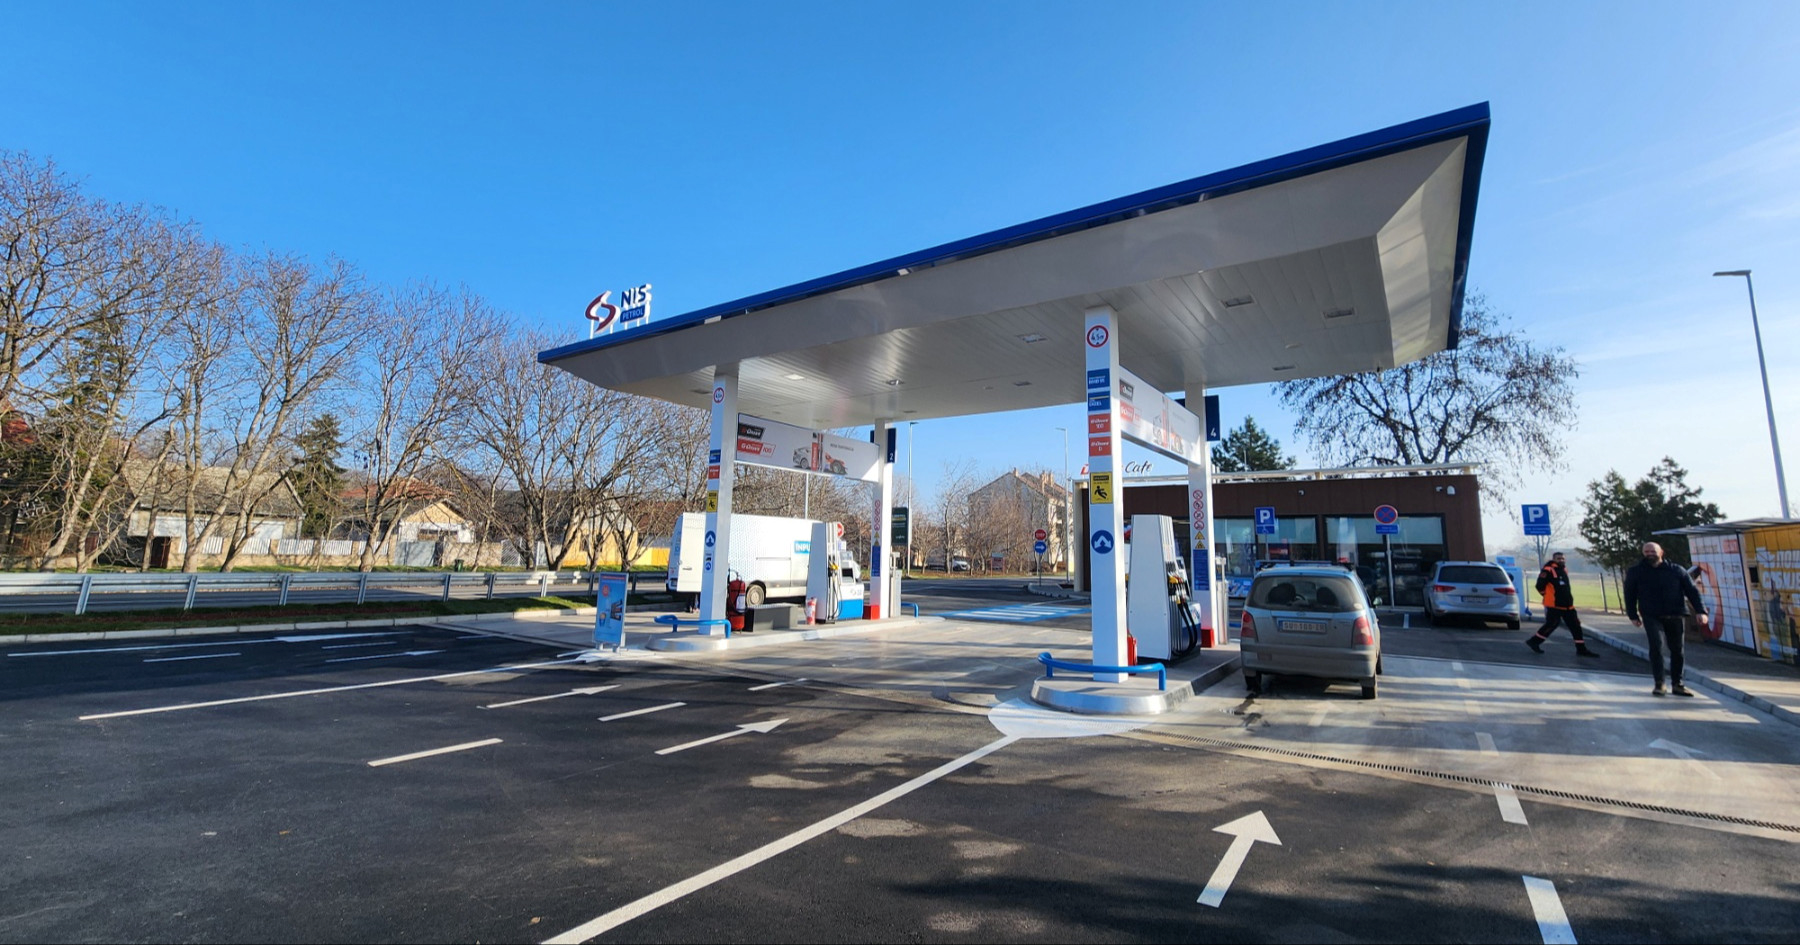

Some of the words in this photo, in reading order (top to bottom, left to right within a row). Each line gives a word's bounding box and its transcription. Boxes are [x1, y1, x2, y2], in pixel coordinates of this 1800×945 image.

[621, 284, 648, 308] NIS
[622, 308, 644, 320] PETROL
[1210, 428, 1216, 437] 4
[1260, 510, 1271, 523] P
[1528, 506, 1544, 523] P
